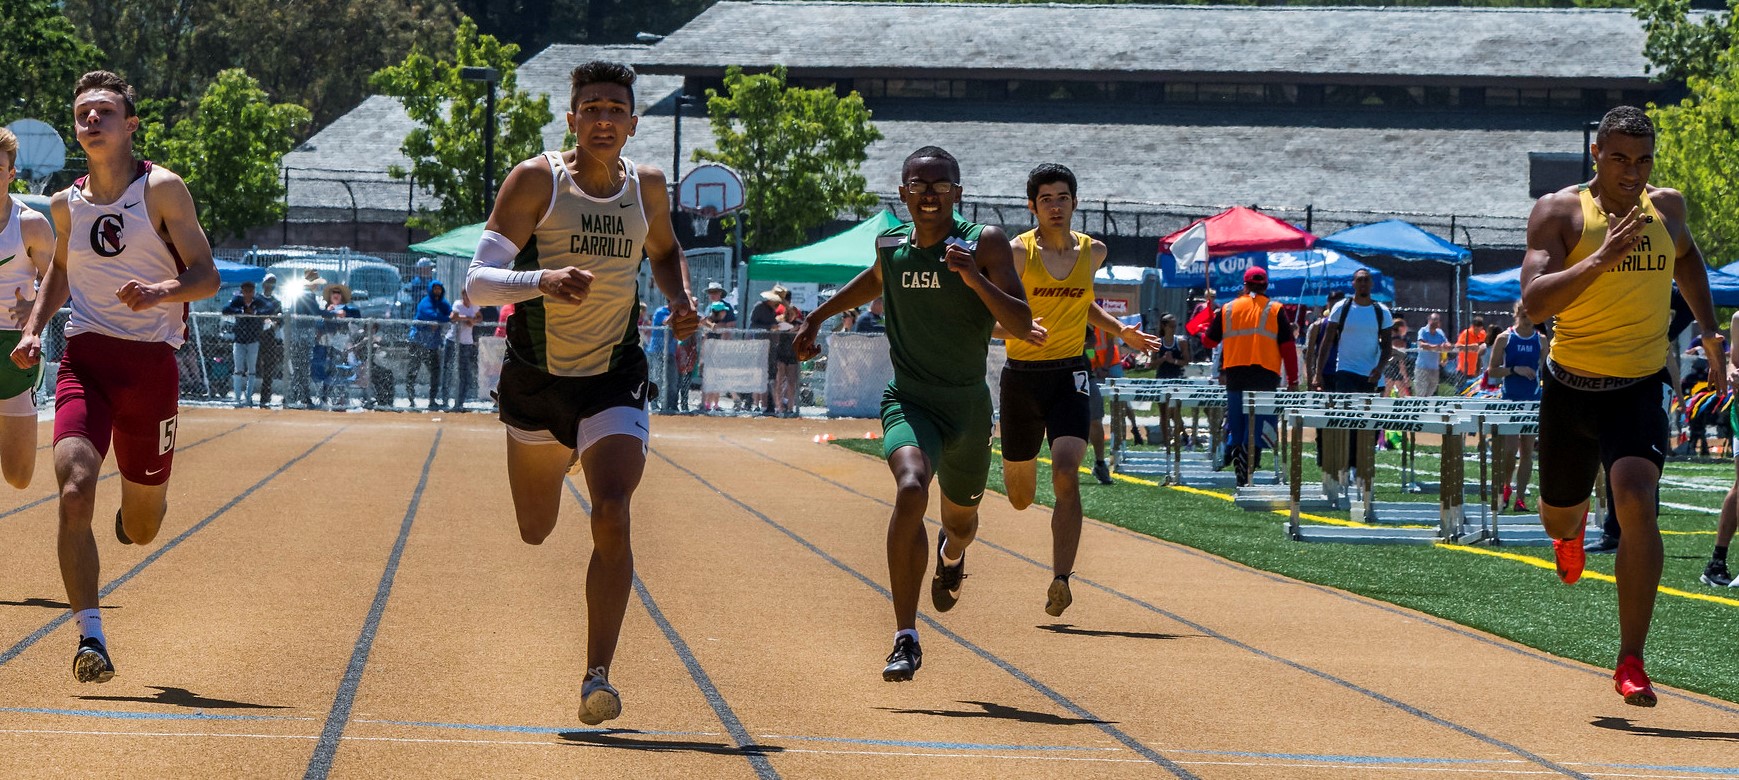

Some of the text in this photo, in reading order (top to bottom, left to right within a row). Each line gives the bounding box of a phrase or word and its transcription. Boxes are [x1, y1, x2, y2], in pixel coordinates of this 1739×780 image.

[581, 213, 625, 236] MARIA
[570, 234, 633, 259] CARRILLO
[1607, 254, 1667, 273] RILLO
[902, 271, 941, 289] CASA
[1032, 287, 1085, 298] VINTAGE
[1517, 344, 1533, 353] TAM
[1077, 372, 1089, 392] 2
[1568, 376, 1601, 389] NIKE
[1485, 403, 1526, 411] MCHS
[1326, 418, 1425, 432] MCHS PUMAS
[164, 418, 174, 451] 5
